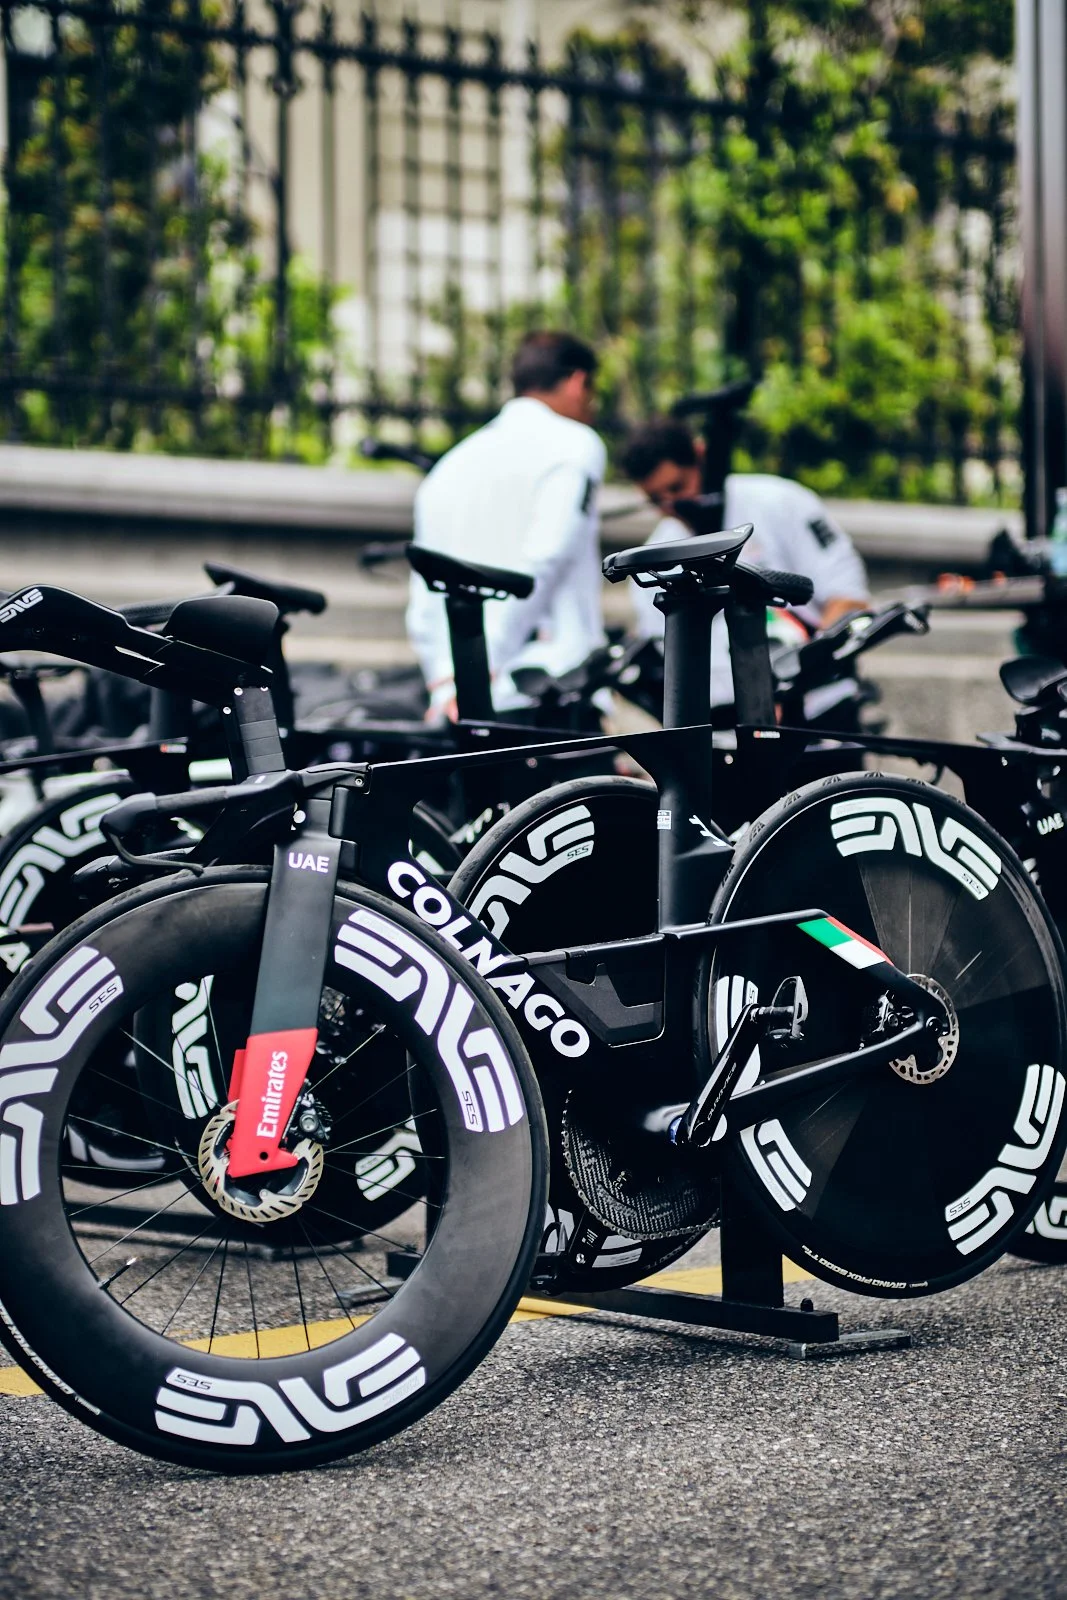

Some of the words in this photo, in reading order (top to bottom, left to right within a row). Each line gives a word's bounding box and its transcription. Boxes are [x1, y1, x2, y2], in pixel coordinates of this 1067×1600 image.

[1037, 813, 1064, 835] UAE
[566, 844, 589, 860] SES
[289, 852, 329, 873] UAE
[387, 861, 590, 1058] COLNAGO
[89, 983, 118, 1014] SES
[256, 1050, 288, 1138] Emirates
[461, 1090, 479, 1127] SES
[949, 1198, 971, 1217] SES
[818, 1257, 849, 1276] 5000
[846, 1271, 873, 1285] PRIX
[871, 1279, 907, 1290] GRAND
[173, 1373, 213, 1391] SES
